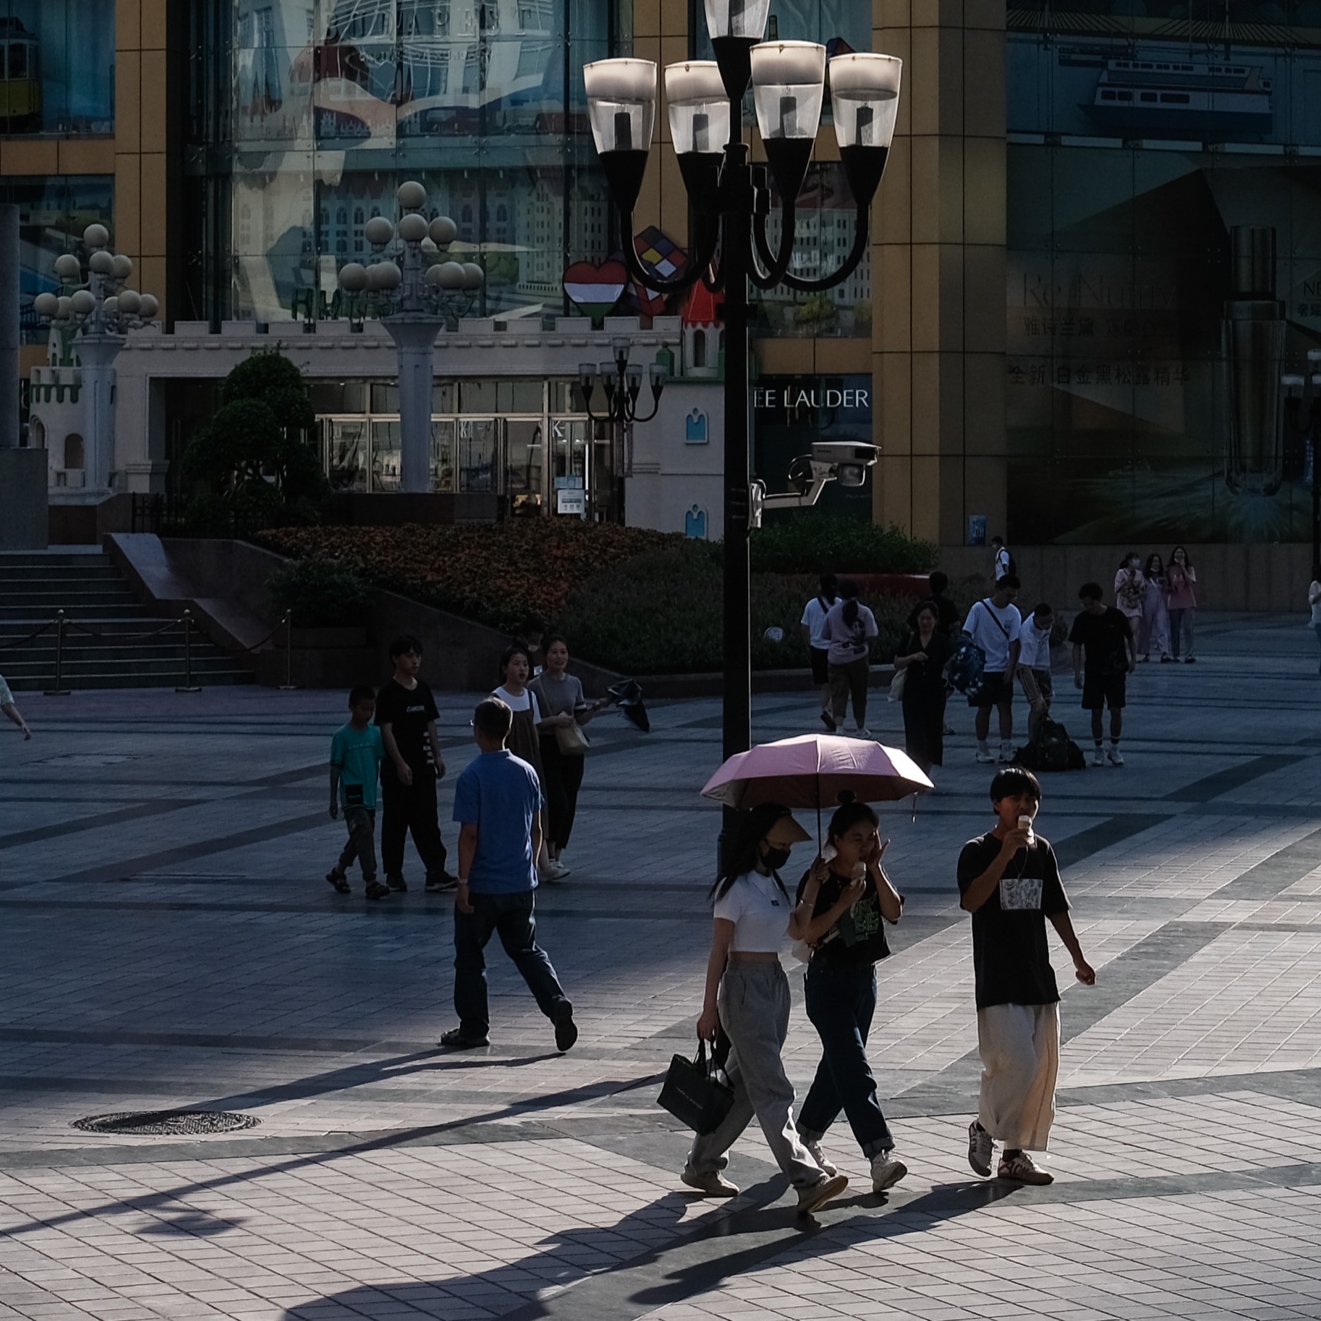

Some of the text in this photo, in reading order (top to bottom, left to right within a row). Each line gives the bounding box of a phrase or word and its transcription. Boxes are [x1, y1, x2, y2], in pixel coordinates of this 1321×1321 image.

[1024, 317, 1095, 337] 雅诗兰黛
[1009, 364, 1190, 386] 全新 白金黑松露精华
[784, 389, 869, 408] LAUDER
